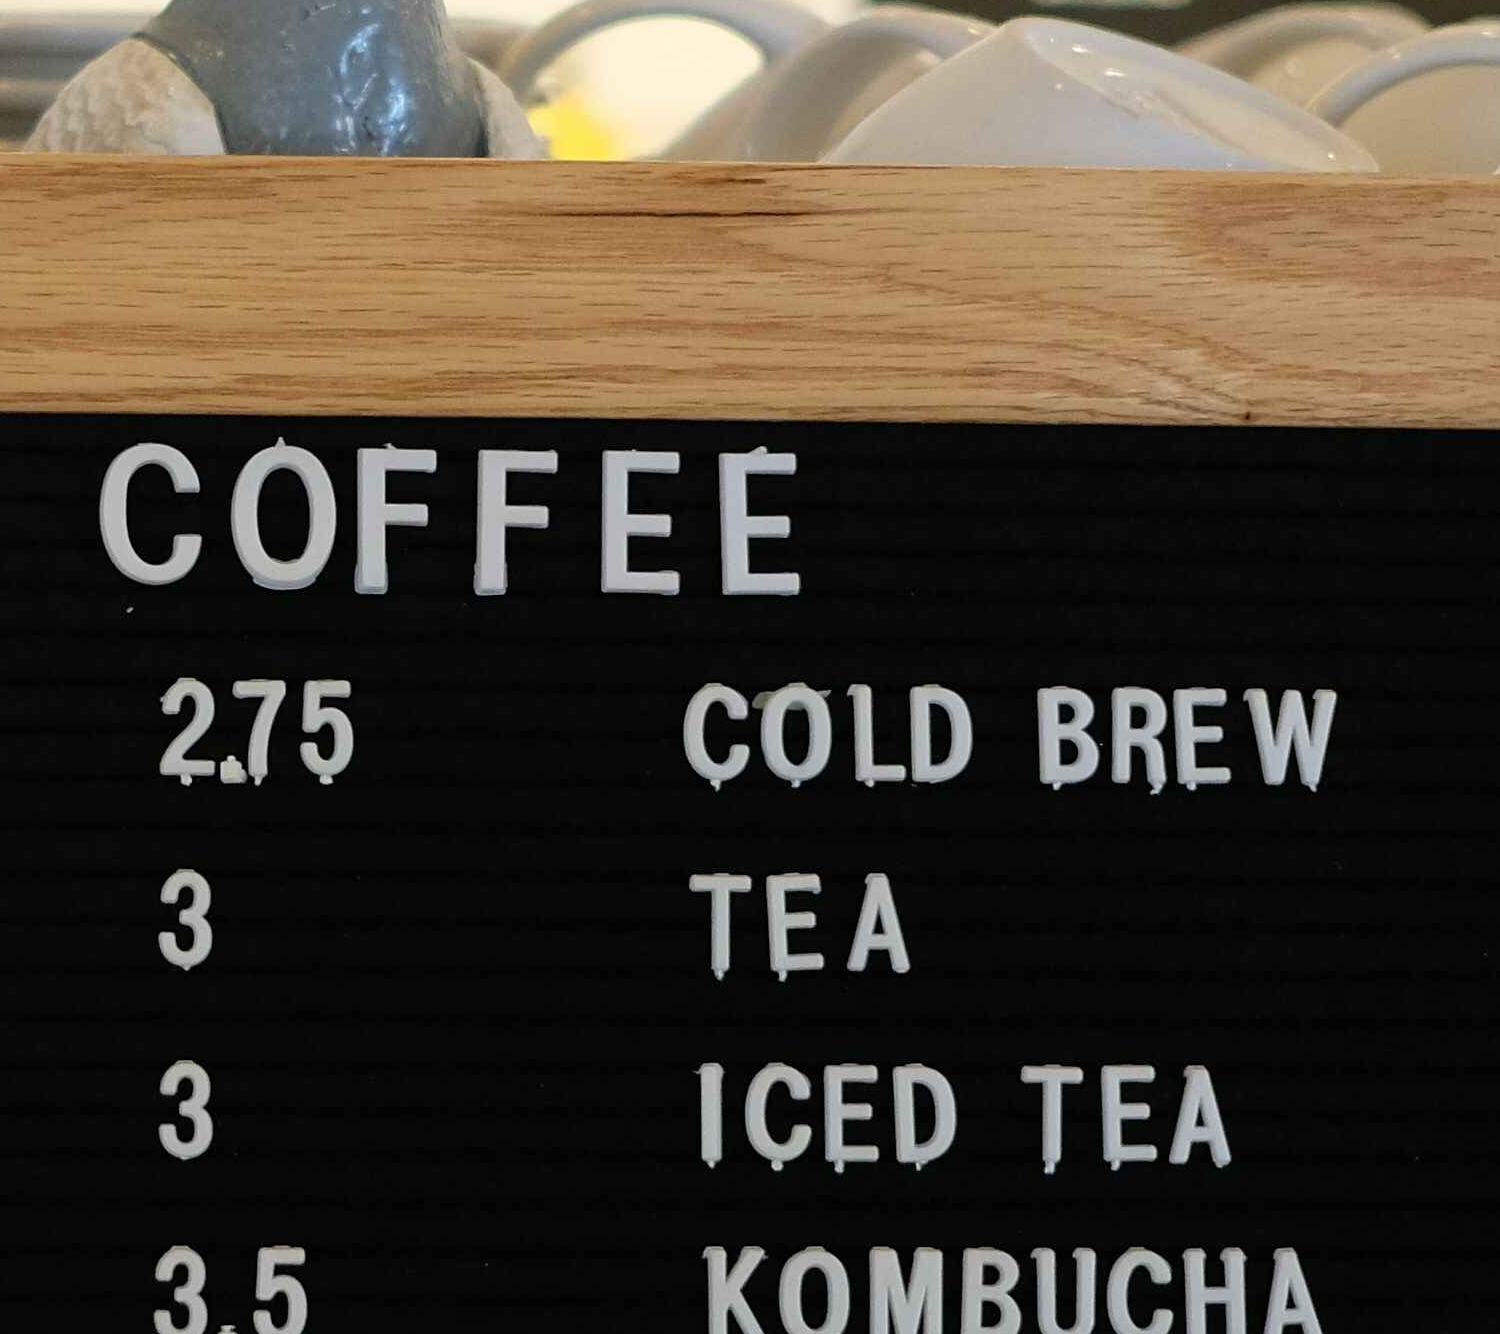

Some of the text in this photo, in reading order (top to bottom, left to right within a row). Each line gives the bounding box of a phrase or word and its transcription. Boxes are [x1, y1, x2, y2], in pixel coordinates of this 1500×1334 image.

[99, 436, 801, 596] COFFEE
[159, 677, 354, 786] 2.75
[683, 682, 973, 791] COLD
[1037, 685, 1337, 795] BREW
[158, 868, 213, 971] 3
[689, 872, 910, 982] TEA
[158, 1059, 213, 1160] 3
[696, 1062, 957, 1174] ICED
[1020, 1064, 1232, 1174] TEA
